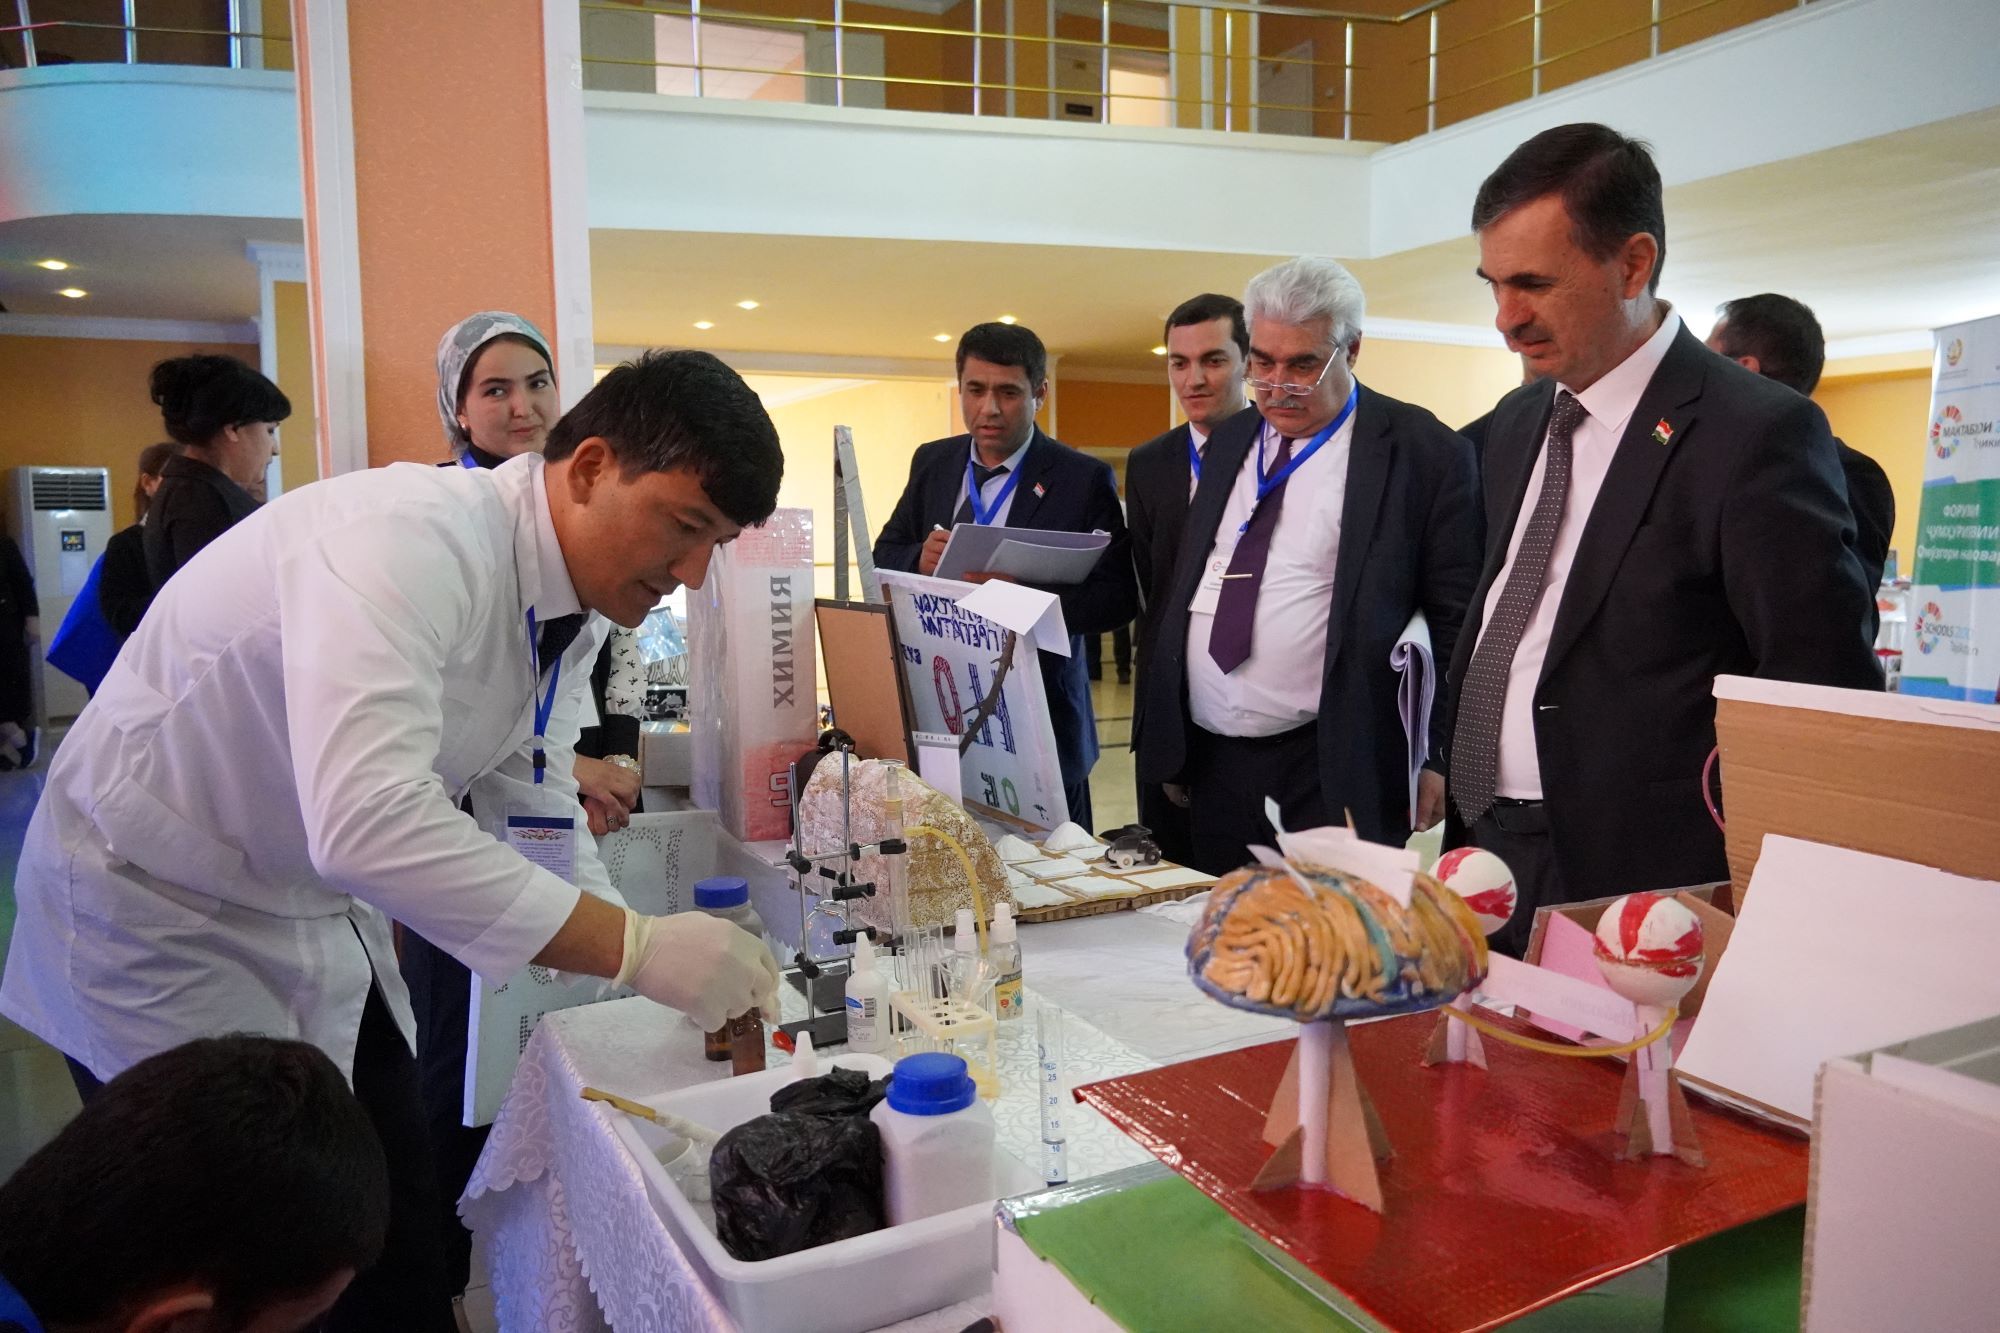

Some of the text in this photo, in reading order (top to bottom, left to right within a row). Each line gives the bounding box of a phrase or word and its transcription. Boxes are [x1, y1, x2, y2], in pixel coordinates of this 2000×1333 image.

[769, 575, 795, 709] ХИМИЯ
[1048, 1073, 1057, 1081] 25
[1050, 1096, 1058, 1105] 20
[1051, 1120, 1059, 1129] 15
